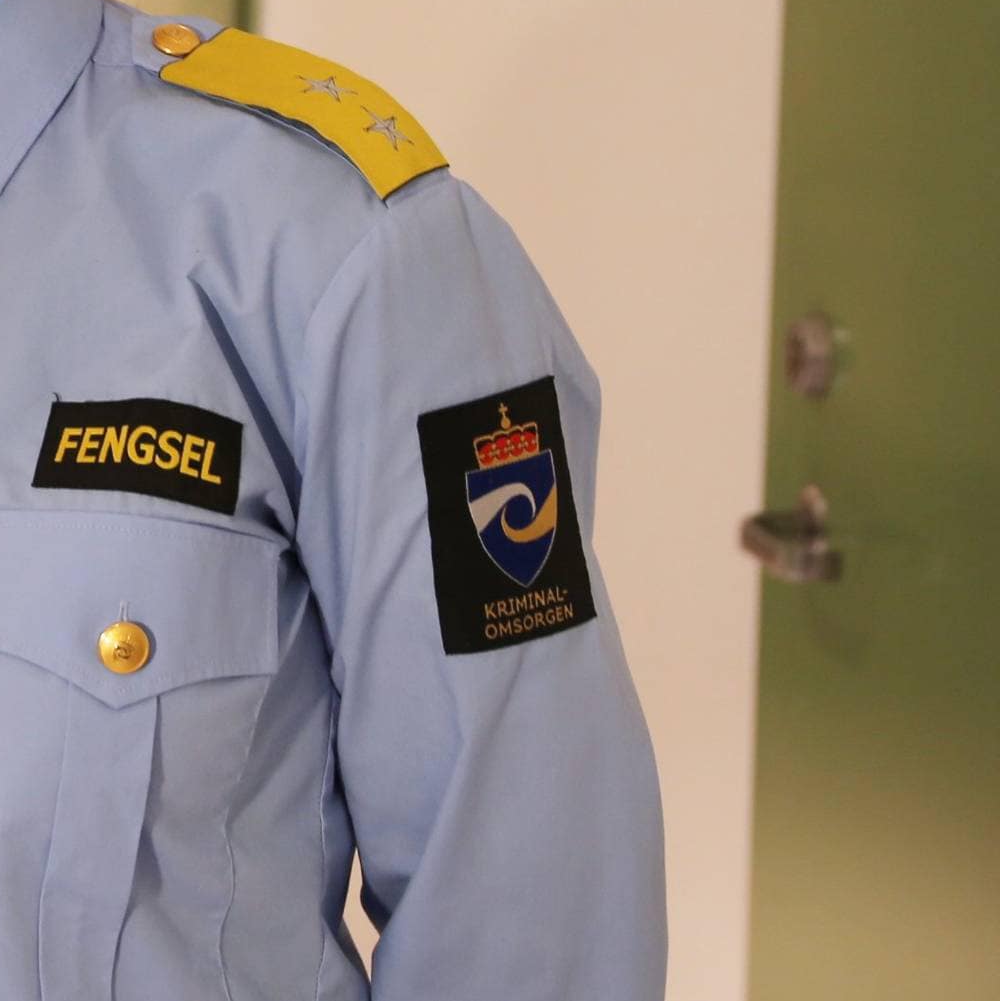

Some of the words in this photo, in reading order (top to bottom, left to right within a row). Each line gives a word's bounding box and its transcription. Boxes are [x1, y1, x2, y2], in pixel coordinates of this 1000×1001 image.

[54, 424, 222, 485] FENGSEL
[484, 586, 568, 619] KRIMINAL-
[484, 603, 574, 639] OMSORGEN
